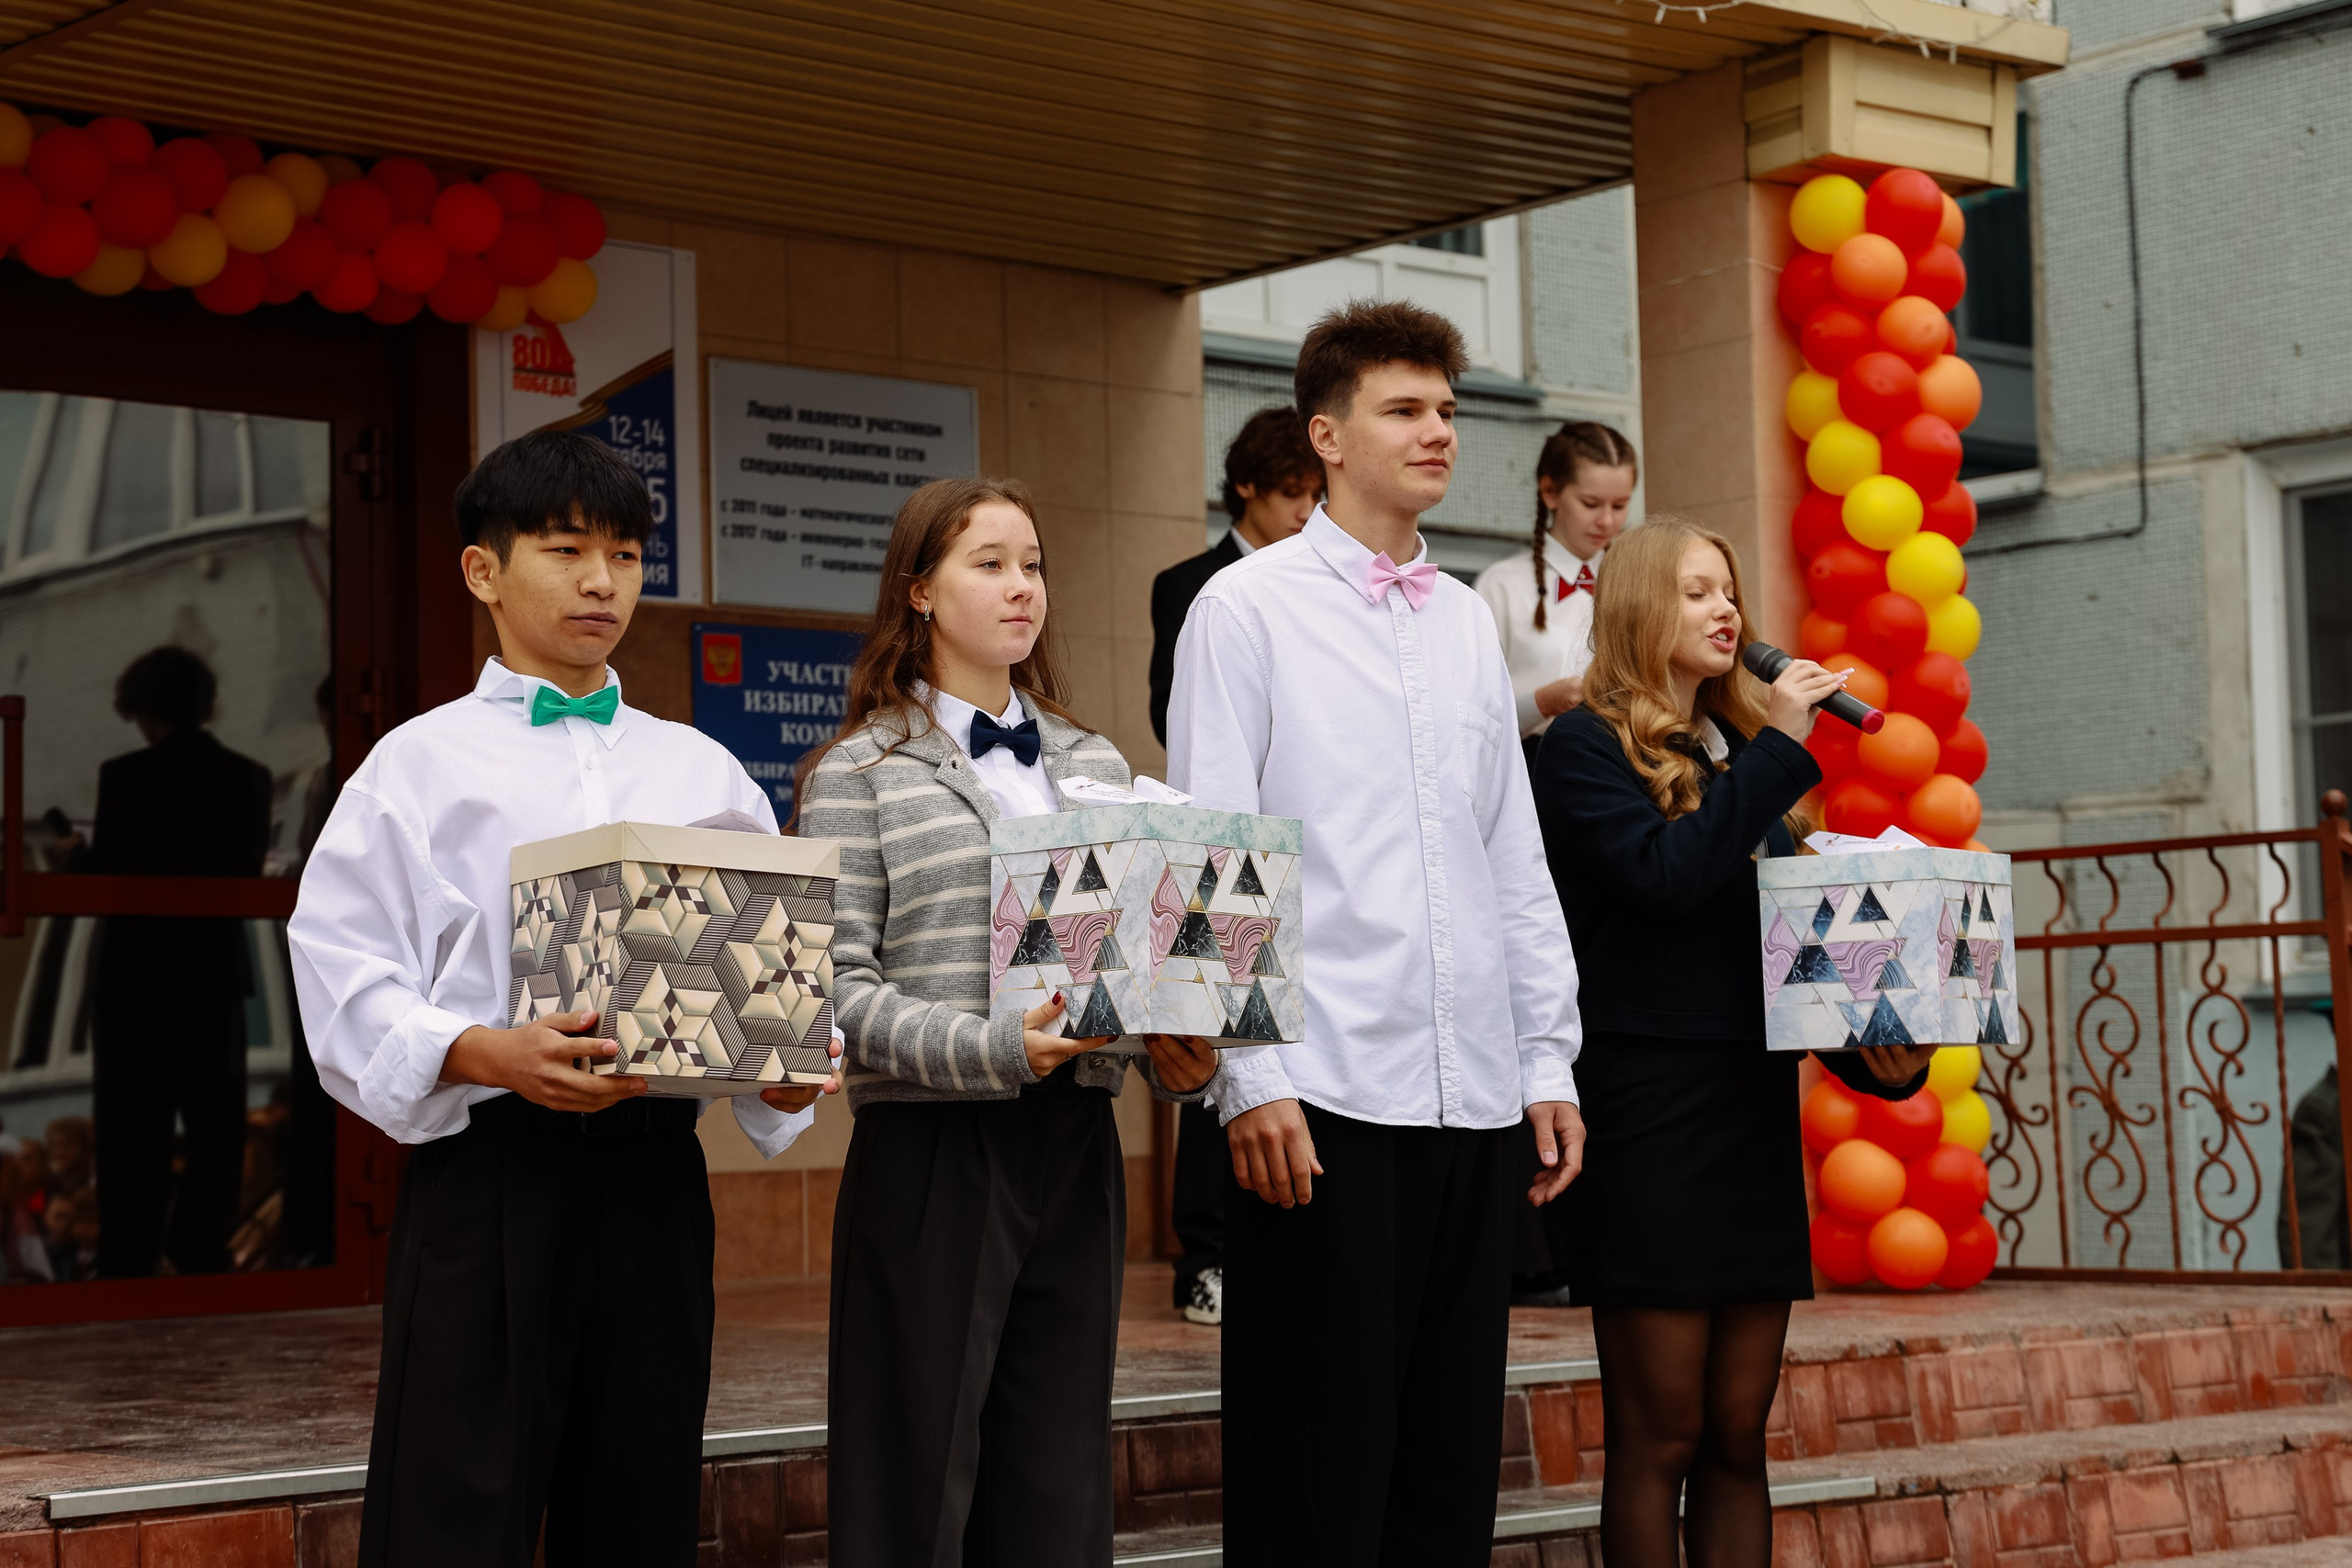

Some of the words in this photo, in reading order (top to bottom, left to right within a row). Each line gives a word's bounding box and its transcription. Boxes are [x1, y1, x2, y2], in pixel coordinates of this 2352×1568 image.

[513, 334, 548, 367] 80
[610, 416, 665, 446] 12-14
[747, 400, 792, 422] Лицей
[797, 409, 862, 429] является
[865, 416, 943, 437] участником
[767, 432, 824, 452] проекта
[829, 439, 890, 458] развития
[896, 446, 925, 462] сети
[740, 457, 889, 485] специализированных
[743, 690, 850, 716] ИЗБИРАТ
